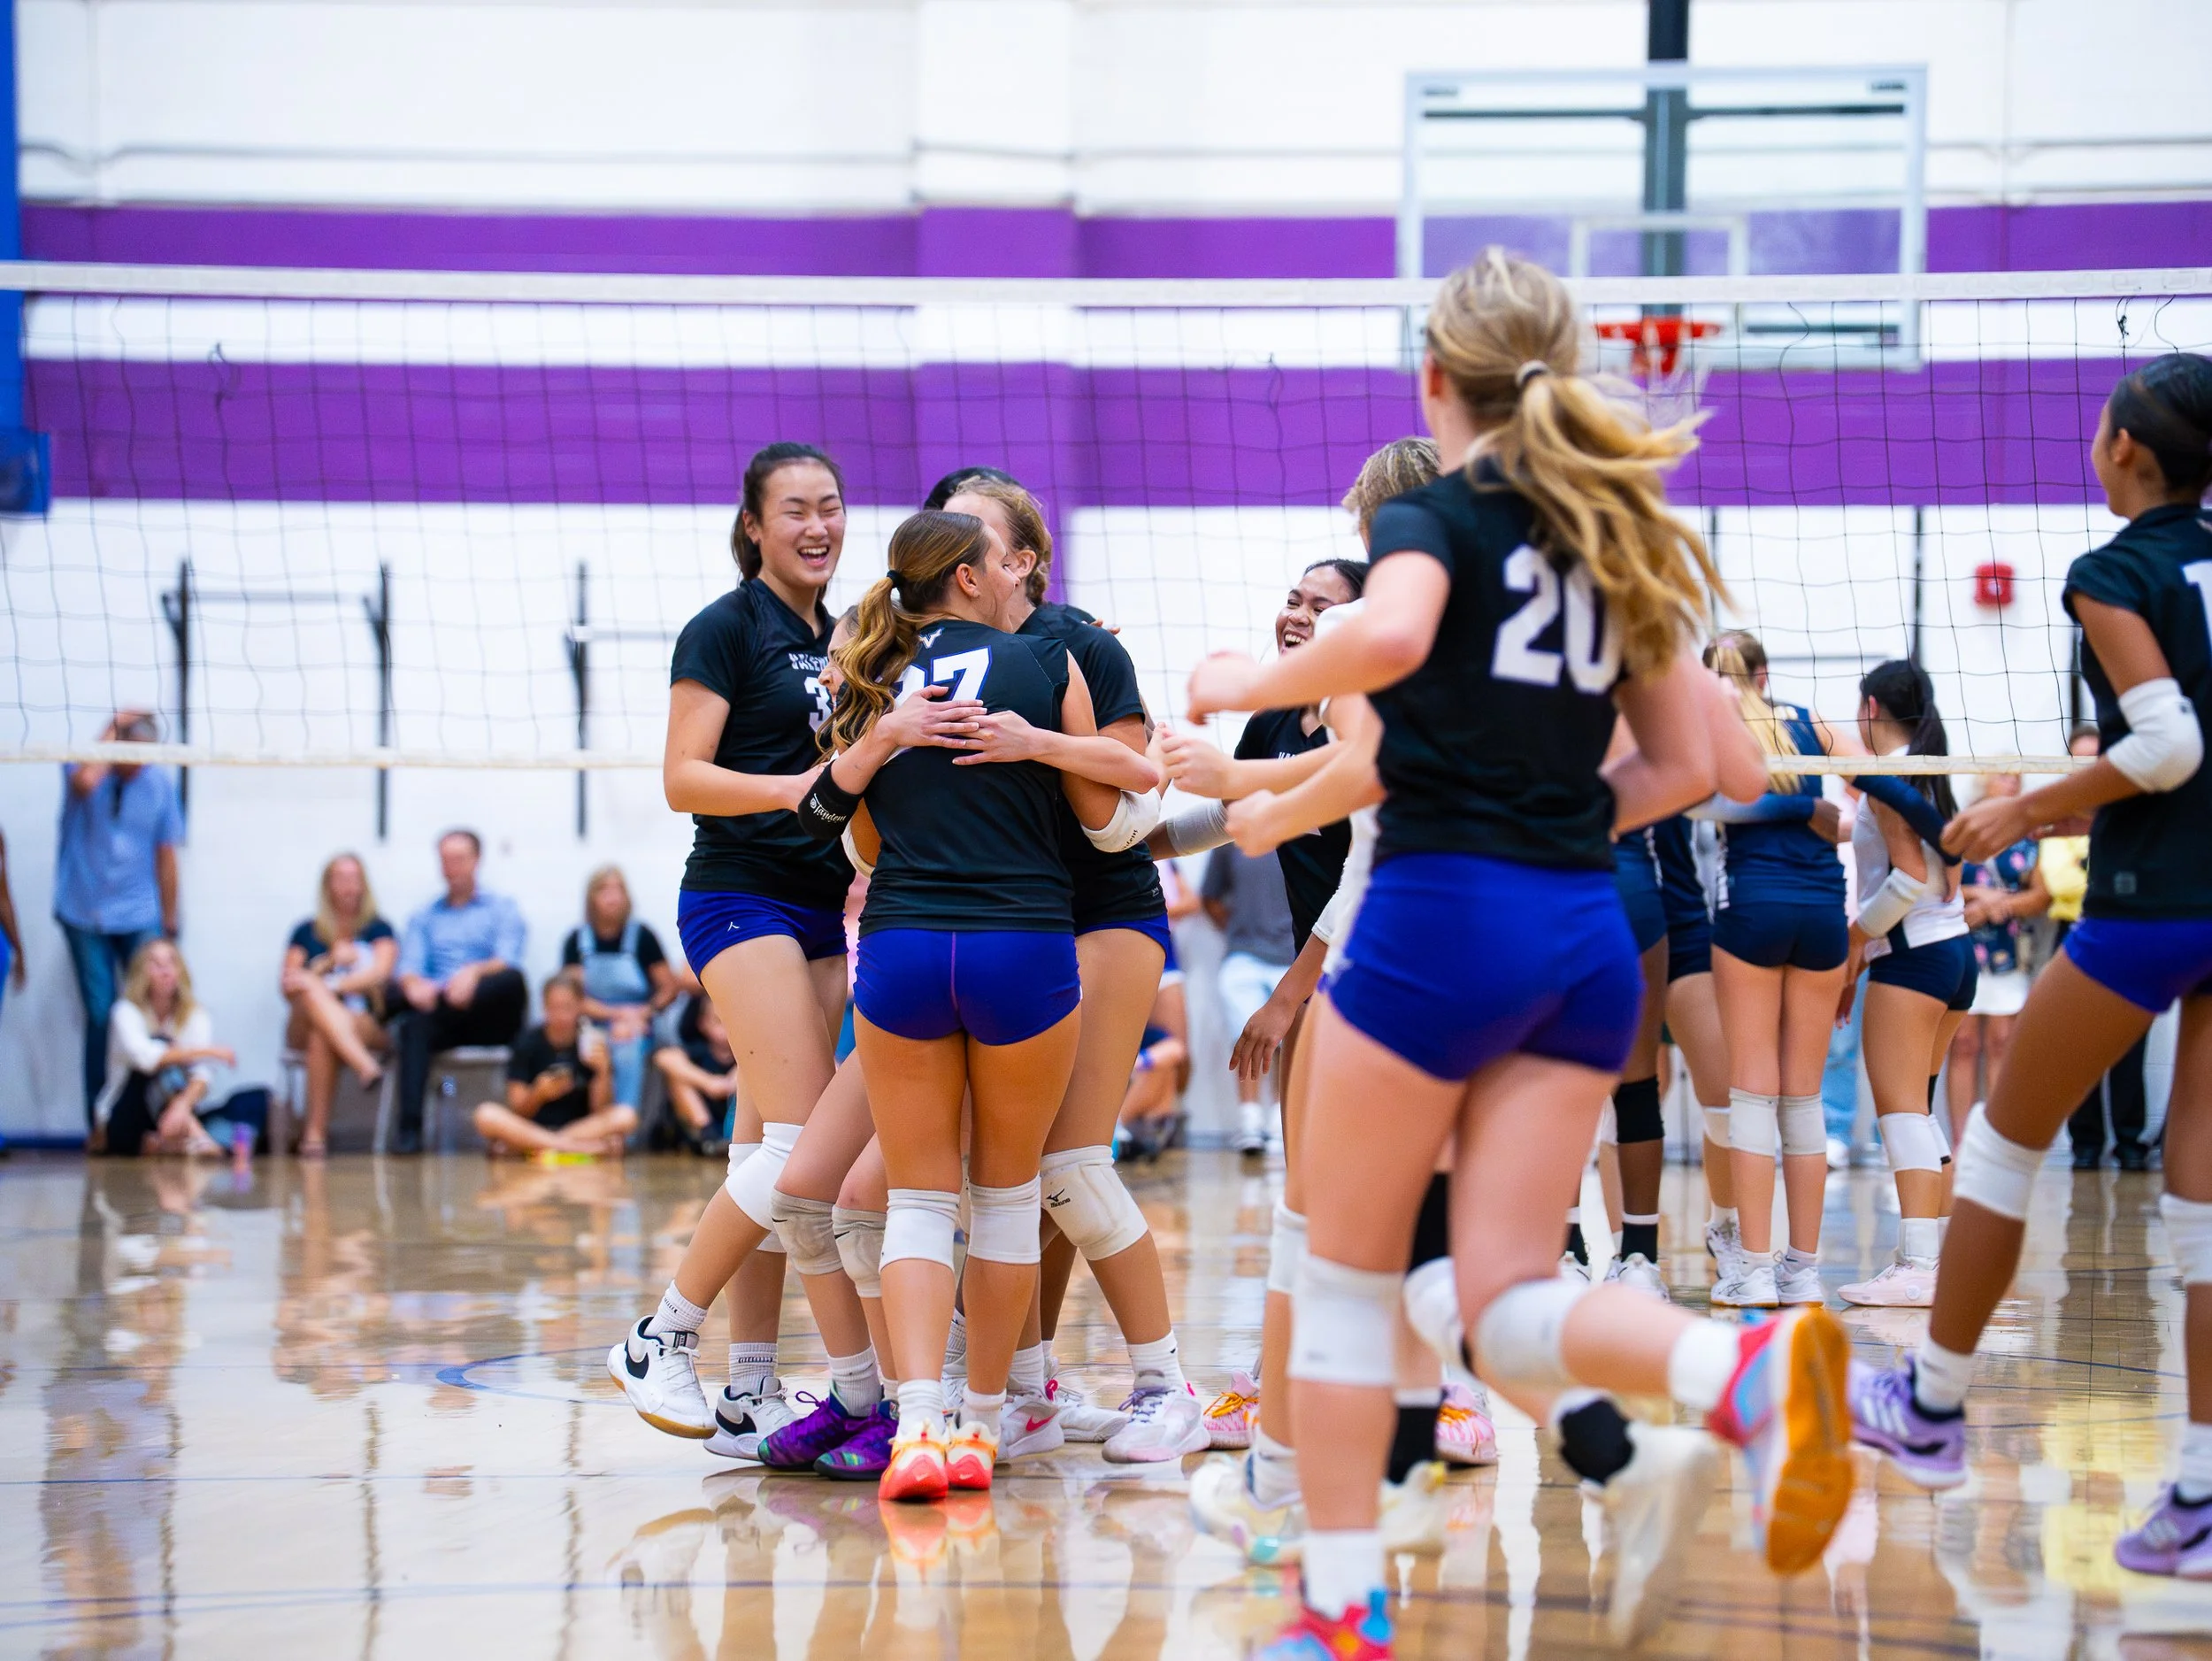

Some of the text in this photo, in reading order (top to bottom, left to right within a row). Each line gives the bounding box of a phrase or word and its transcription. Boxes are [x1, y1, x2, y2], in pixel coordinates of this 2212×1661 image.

[1491, 543, 1624, 694] 20
[804, 677, 833, 734] 3
[811, 793, 847, 823] Tandem
